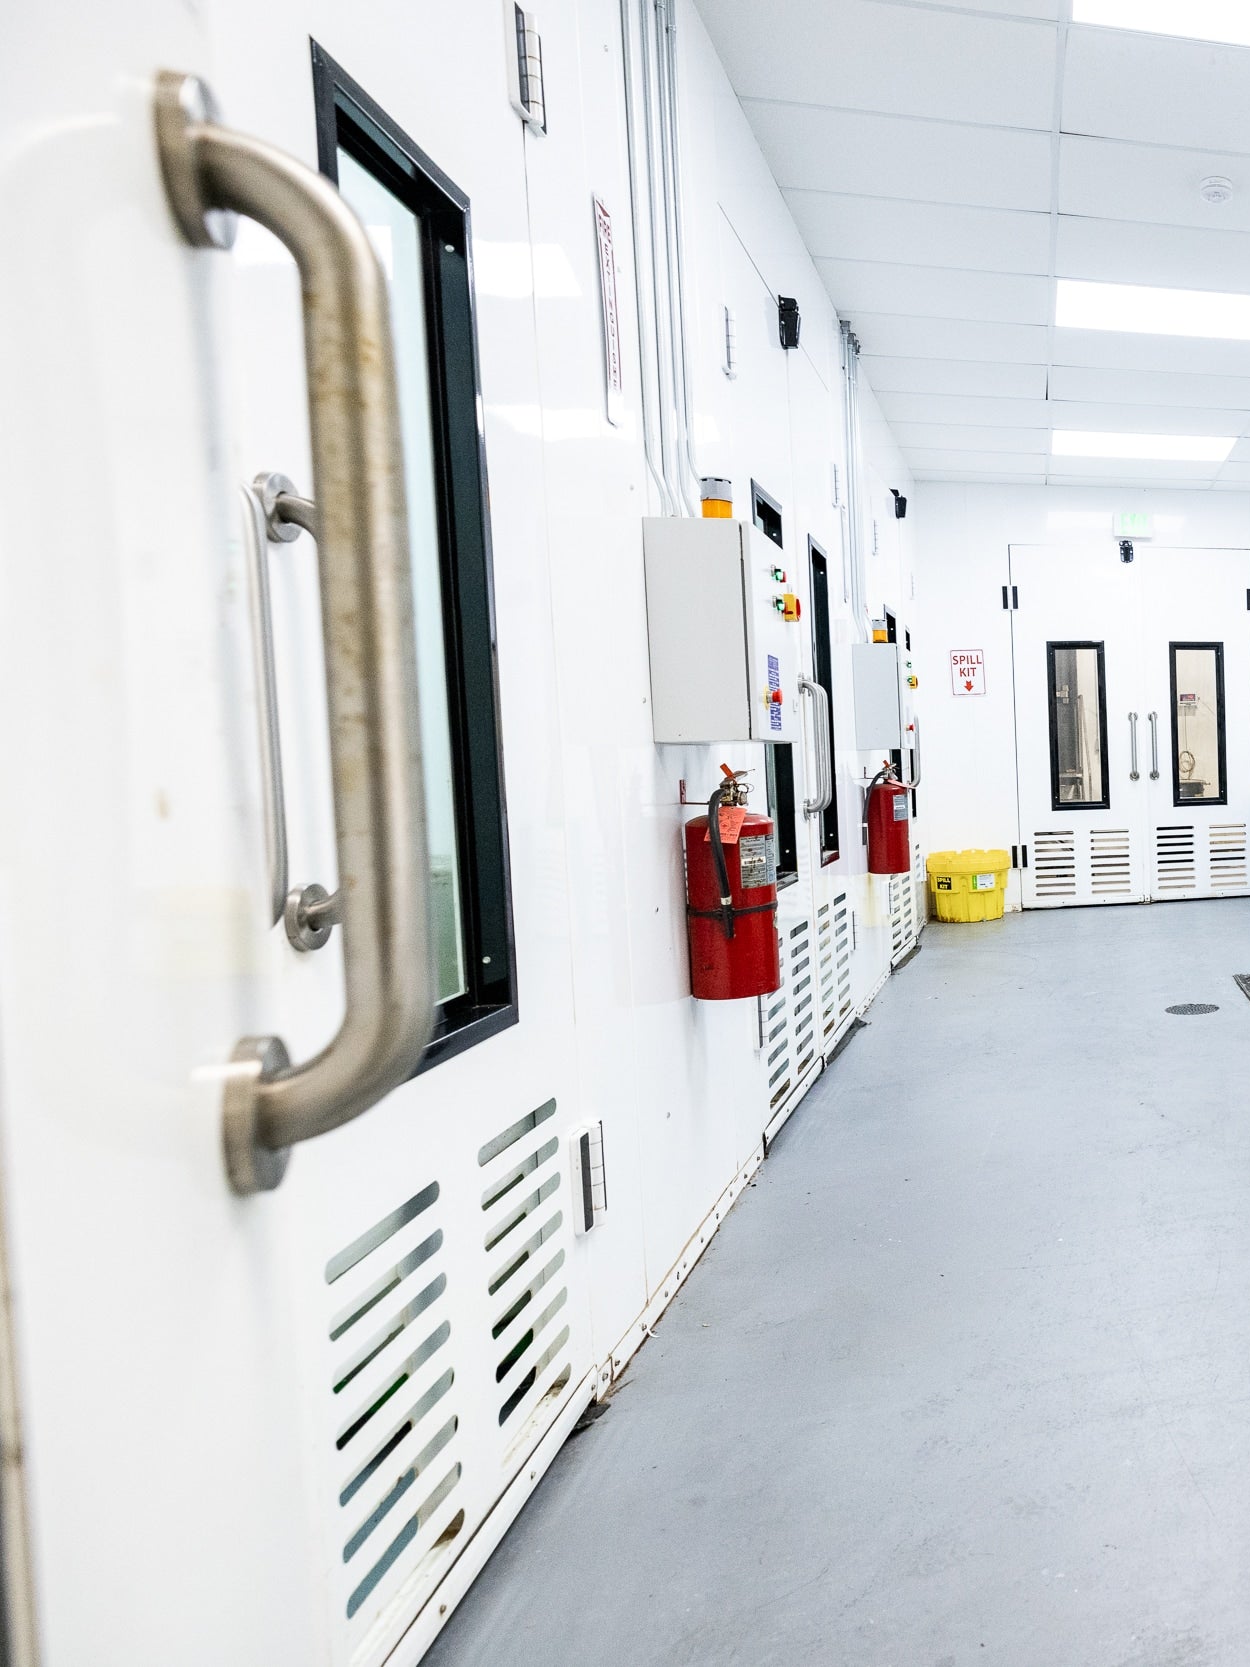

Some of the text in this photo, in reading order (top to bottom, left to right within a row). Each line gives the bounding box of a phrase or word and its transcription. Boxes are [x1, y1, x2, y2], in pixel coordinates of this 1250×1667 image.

[604, 243, 618, 391] EXTINGUISHE
[952, 655, 982, 665] SPILL
[959, 667, 976, 677] KIT
